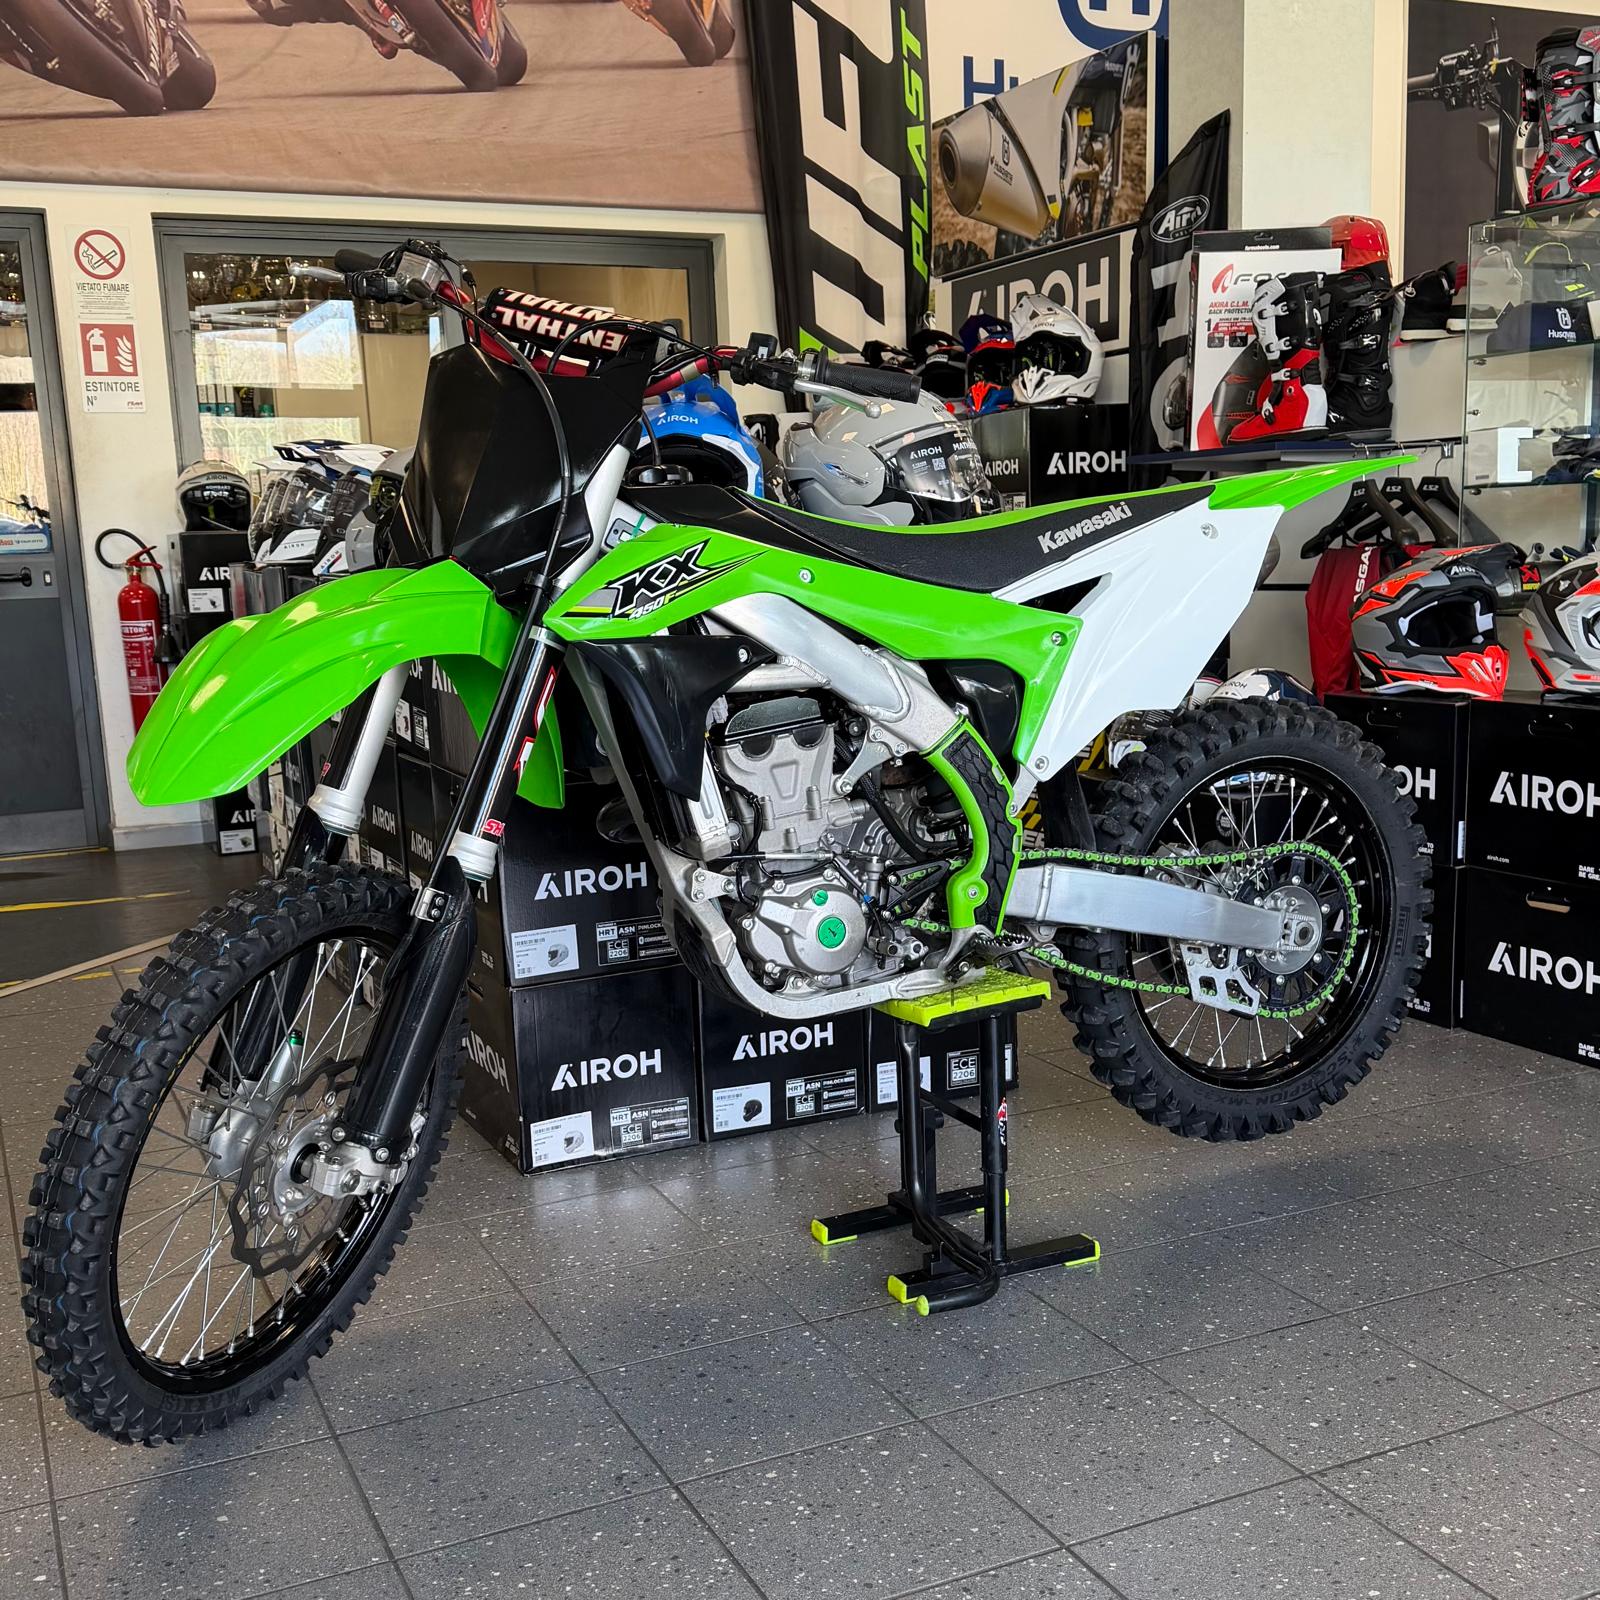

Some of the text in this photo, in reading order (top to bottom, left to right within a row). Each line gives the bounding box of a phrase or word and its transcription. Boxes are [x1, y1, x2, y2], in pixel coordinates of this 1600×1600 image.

[900, 6, 930, 282] PLAST
[76, 282, 130, 293] VIETATO FUMARE
[1208, 301, 1229, 309] AKIRA
[85, 381, 141, 393] ESTINTORE
[657, 413, 698, 426] AIROH
[909, 446, 942, 460] AIROH
[984, 459, 1019, 477] AIROH
[1046, 450, 1127, 475] AIROH
[1353, 488, 1366, 497] LS2
[1385, 485, 1402, 493] LS2
[1422, 484, 1439, 492] LS2
[1037, 501, 1133, 554] Kawasaki
[607, 541, 710, 615] KX
[627, 590, 677, 620] 450F
[372, 804, 397, 836] AIROH
[410, 830, 434, 863] AIROH
[1578, 864, 1595, 874] DARE
[534, 861, 648, 901] AIROH
[598, 925, 636, 938] HRT ASN
[608, 939, 629, 950] ECE
[608, 948, 629, 958] 2206
[732, 1021, 834, 1061] AIROH
[1578, 1042, 1595, 1052] DARE
[551, 1048, 662, 1092] AIROH
[952, 1058, 977, 1070] ECE
[953, 1069, 976, 1080] 2206
[787, 1081, 821, 1093] HRT ASN
[795, 1094, 815, 1105] ECE
[611, 1110, 650, 1122] HRT ASN
[621, 1123, 643, 1135] ECE
[621, 1133, 643, 1143] 2206
